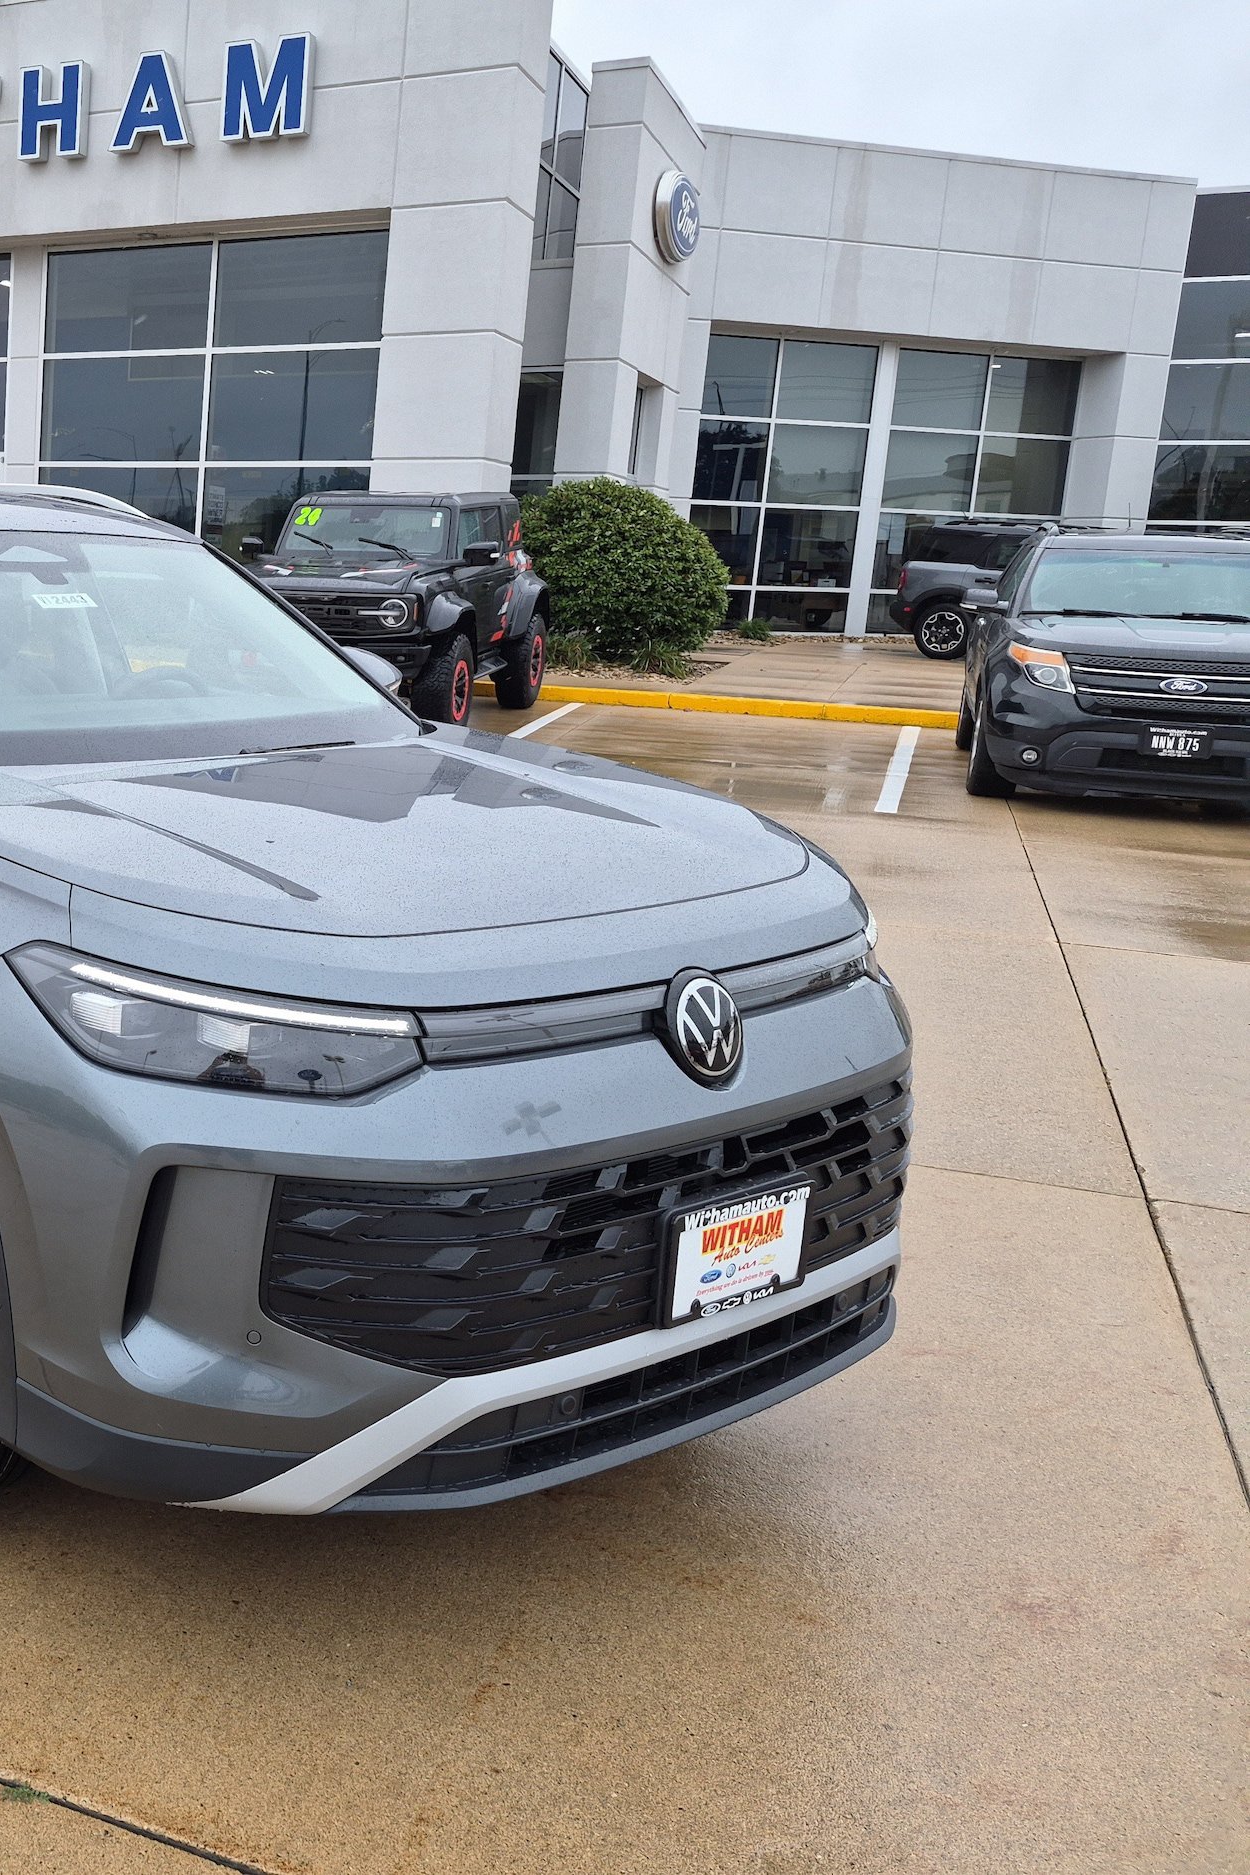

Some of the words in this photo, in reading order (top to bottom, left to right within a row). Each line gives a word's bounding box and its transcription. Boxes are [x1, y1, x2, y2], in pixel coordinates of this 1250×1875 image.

[677, 190, 698, 245] Ford
[294, 506, 322, 526] 24
[1170, 681, 1197, 691] Ford
[1151, 735, 1175, 749] NNW
[1177, 737, 1200, 751] 875
[702, 1209, 784, 1255] WITHAM
[711, 1246, 740, 1267] Auto
[744, 1230, 784, 1254] Centers
